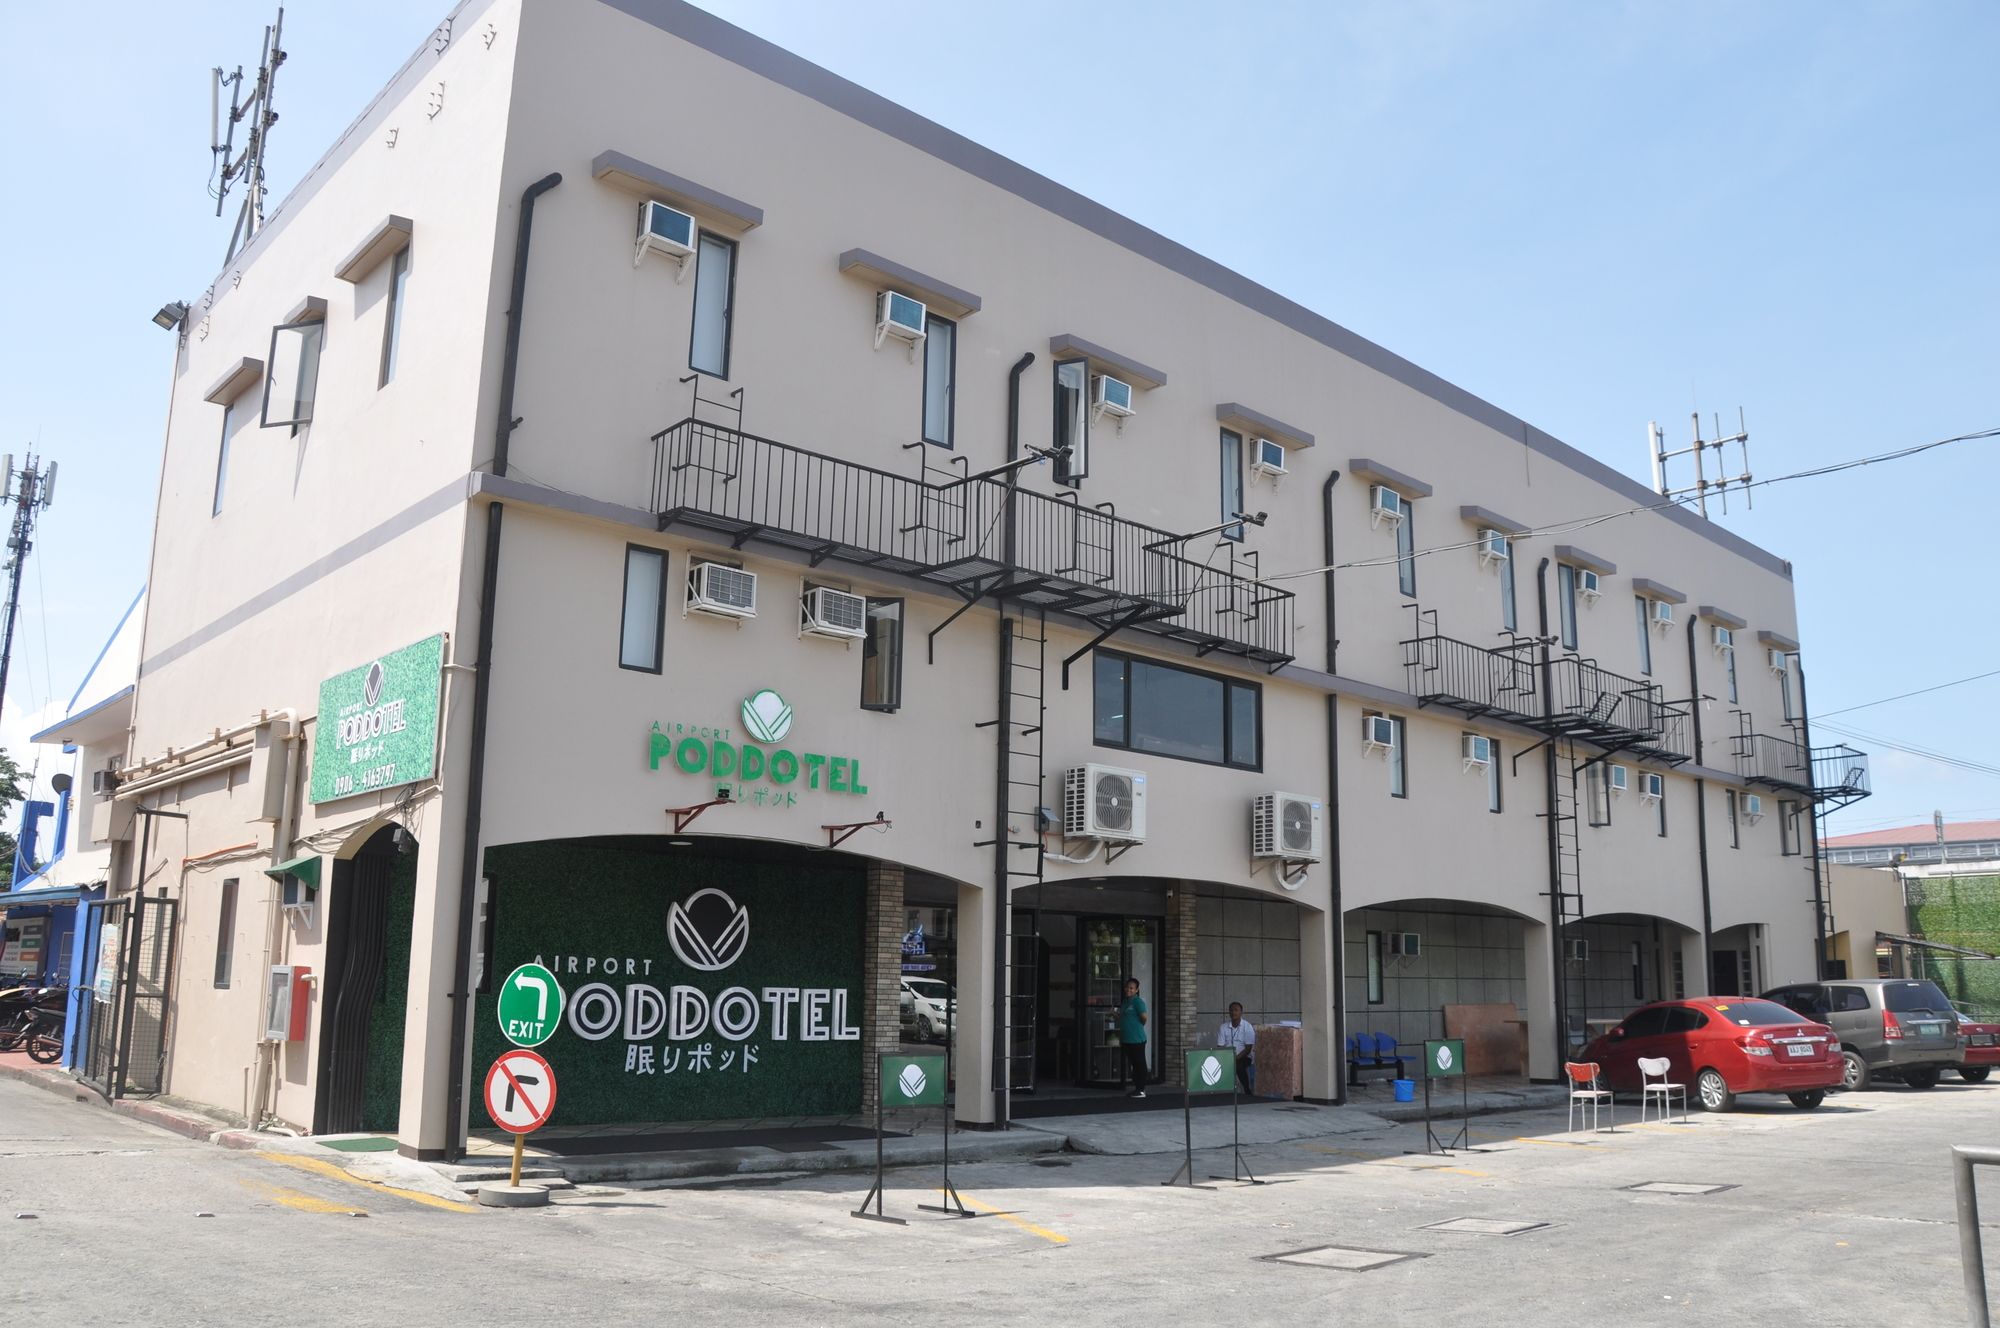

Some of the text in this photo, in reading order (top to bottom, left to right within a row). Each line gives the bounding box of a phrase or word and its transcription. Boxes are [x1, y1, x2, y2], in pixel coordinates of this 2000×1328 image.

[336, 699, 407, 751] PODDOTEL
[651, 720, 732, 741] AIRPORT
[648, 733, 869, 795] PODDOTEL
[533, 954, 652, 976] AIRPORT
[560, 982, 861, 1042] ODDOTEL
[508, 1019, 544, 1040] EXIT
[624, 1042, 759, 1076] 眠りポッド
